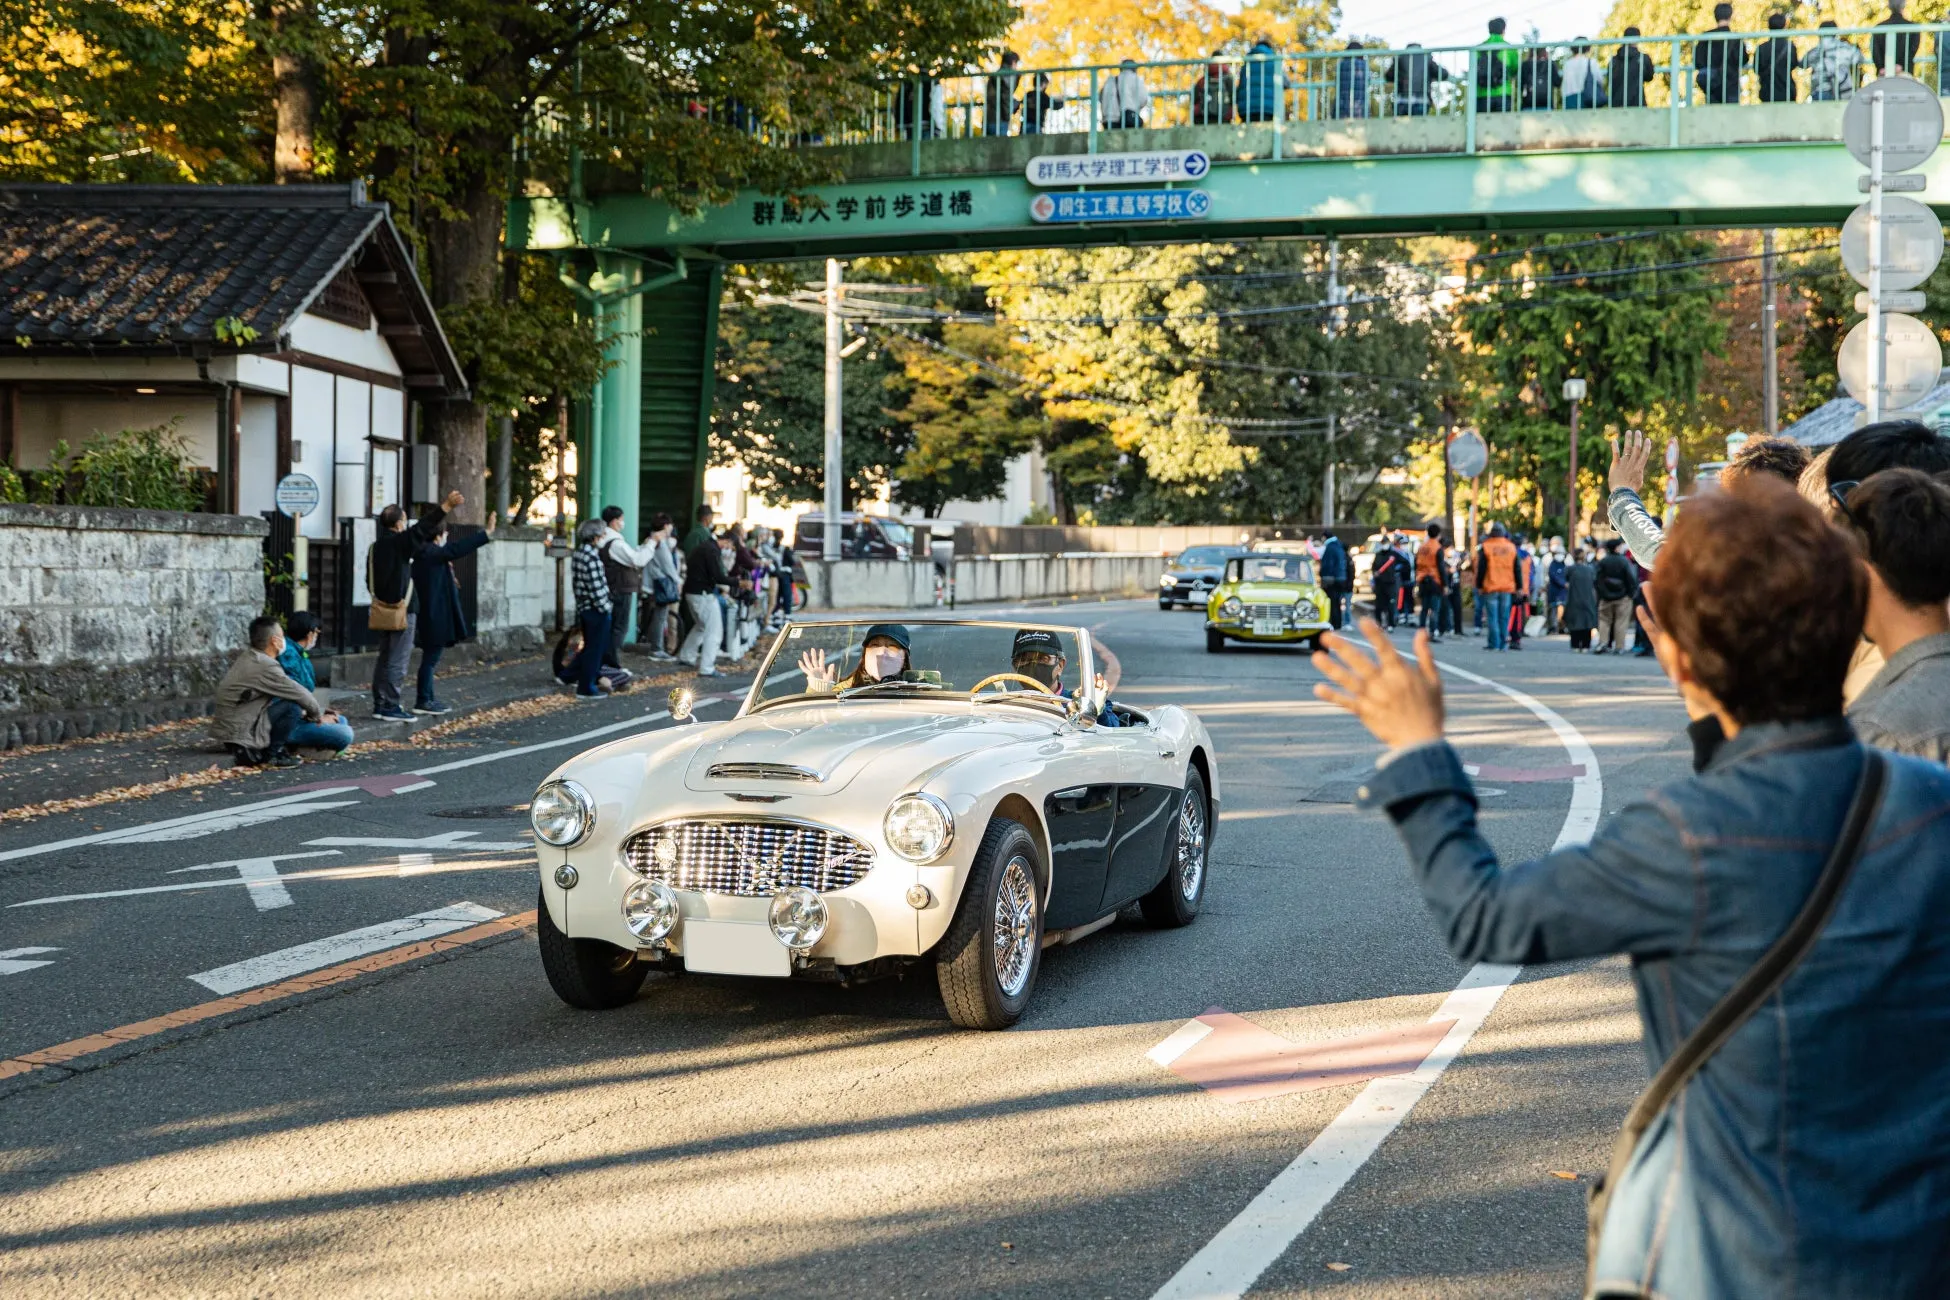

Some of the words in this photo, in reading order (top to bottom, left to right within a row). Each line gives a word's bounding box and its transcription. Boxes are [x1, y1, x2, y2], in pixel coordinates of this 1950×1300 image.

[1038, 156, 1180, 179] 群馬大学理工学部
[1058, 194, 1183, 216] 桐生工業高等学校
